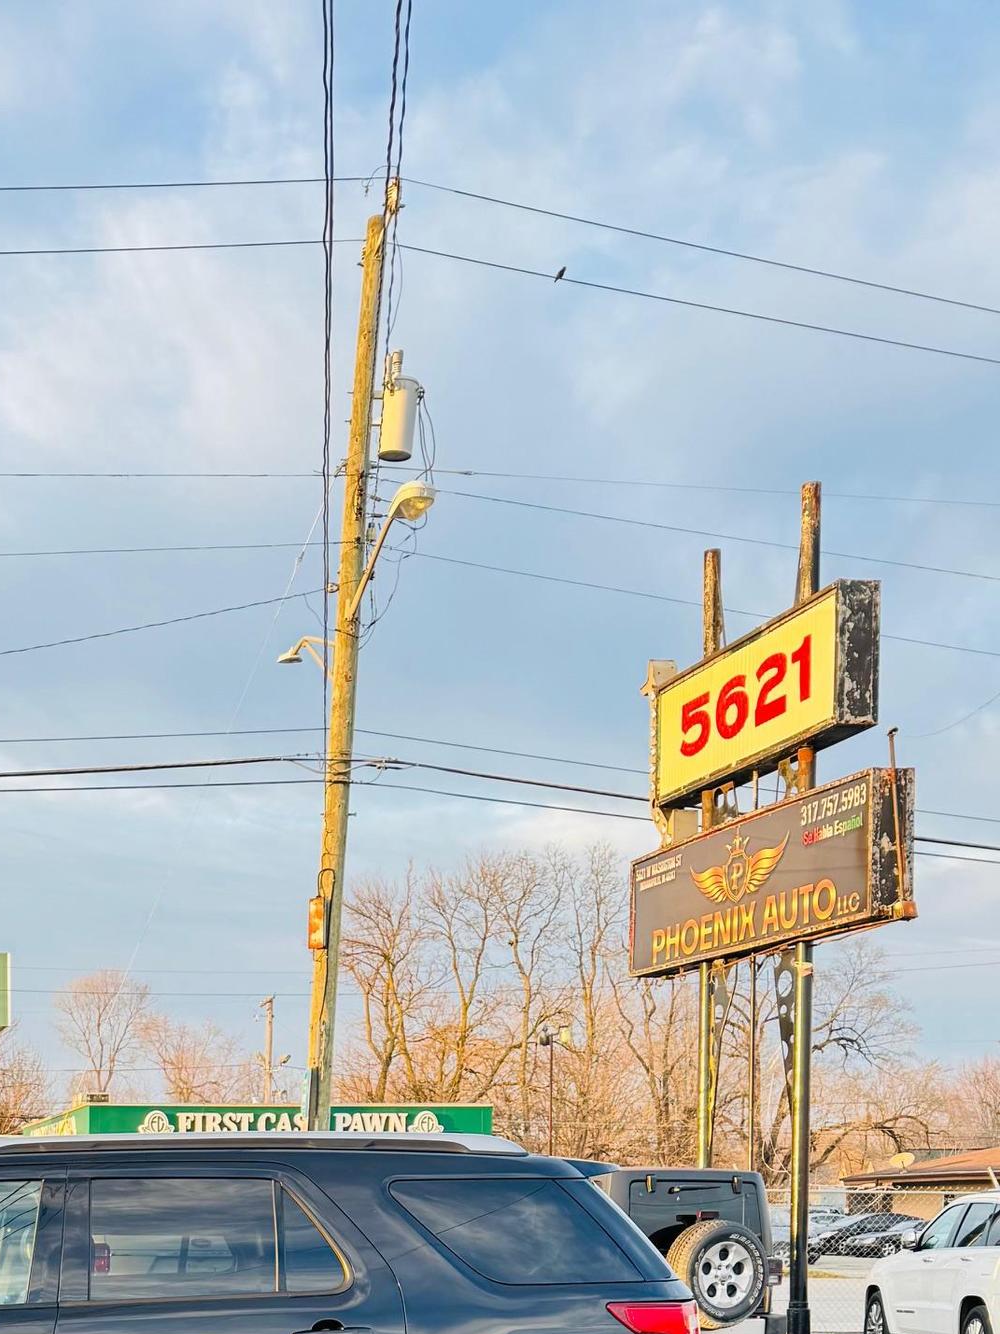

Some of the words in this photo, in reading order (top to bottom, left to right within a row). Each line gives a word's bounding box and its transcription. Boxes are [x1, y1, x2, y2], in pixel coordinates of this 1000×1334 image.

[680, 634, 812, 757] 5621
[800, 783, 867, 826] 317.757.5983
[834, 811, 863, 836] Español
[652, 901, 757, 964] PHOENIX
[762, 878, 837, 935] AUTO
[837, 892, 861, 915] LLC
[176, 1112, 254, 1132] FIRST
[256, 1112, 309, 1132] CAS
[333, 1112, 408, 1132] PAWN
